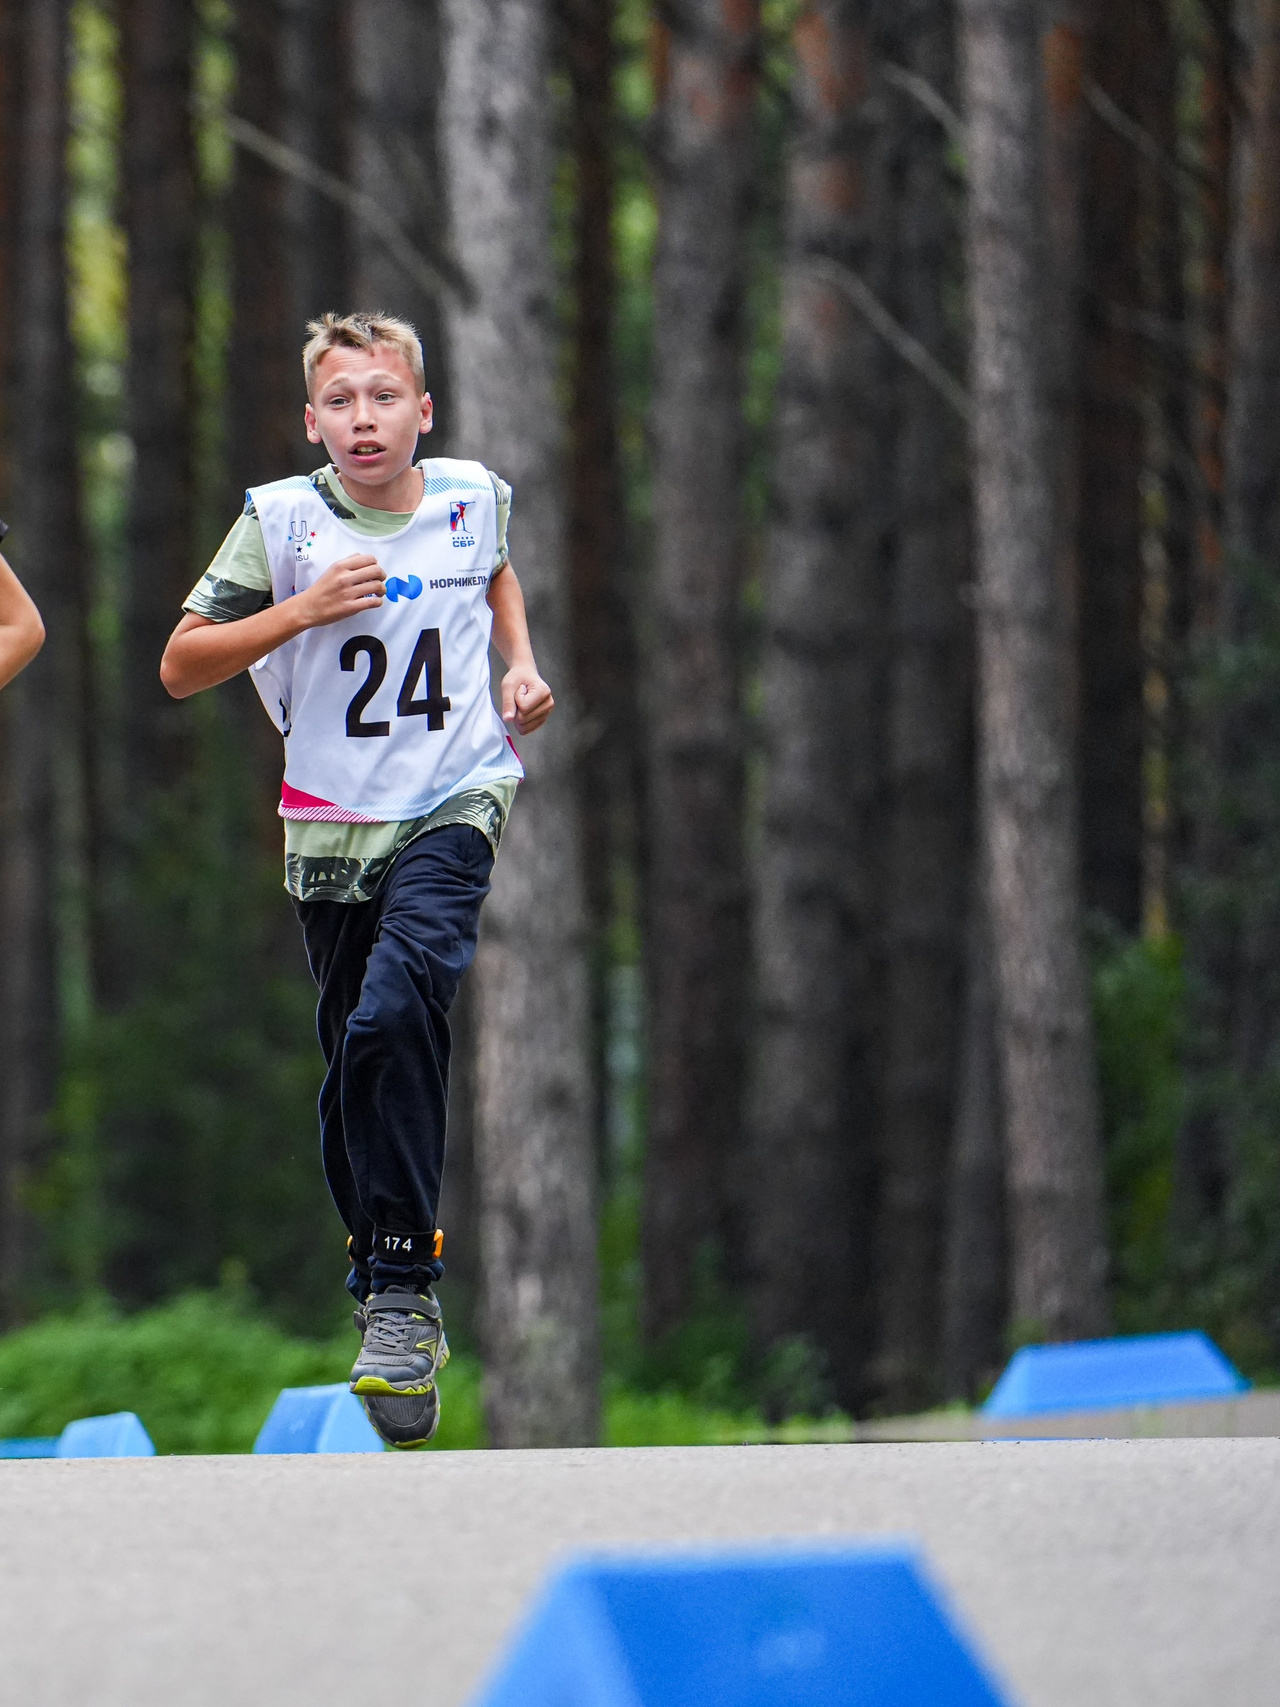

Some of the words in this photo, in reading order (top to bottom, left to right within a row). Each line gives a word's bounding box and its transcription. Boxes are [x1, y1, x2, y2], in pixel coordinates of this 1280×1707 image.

[452, 540, 475, 548] СБР
[295, 554, 309, 562] ISU
[339, 628, 451, 738] 24
[384, 1235, 413, 1252] 174
